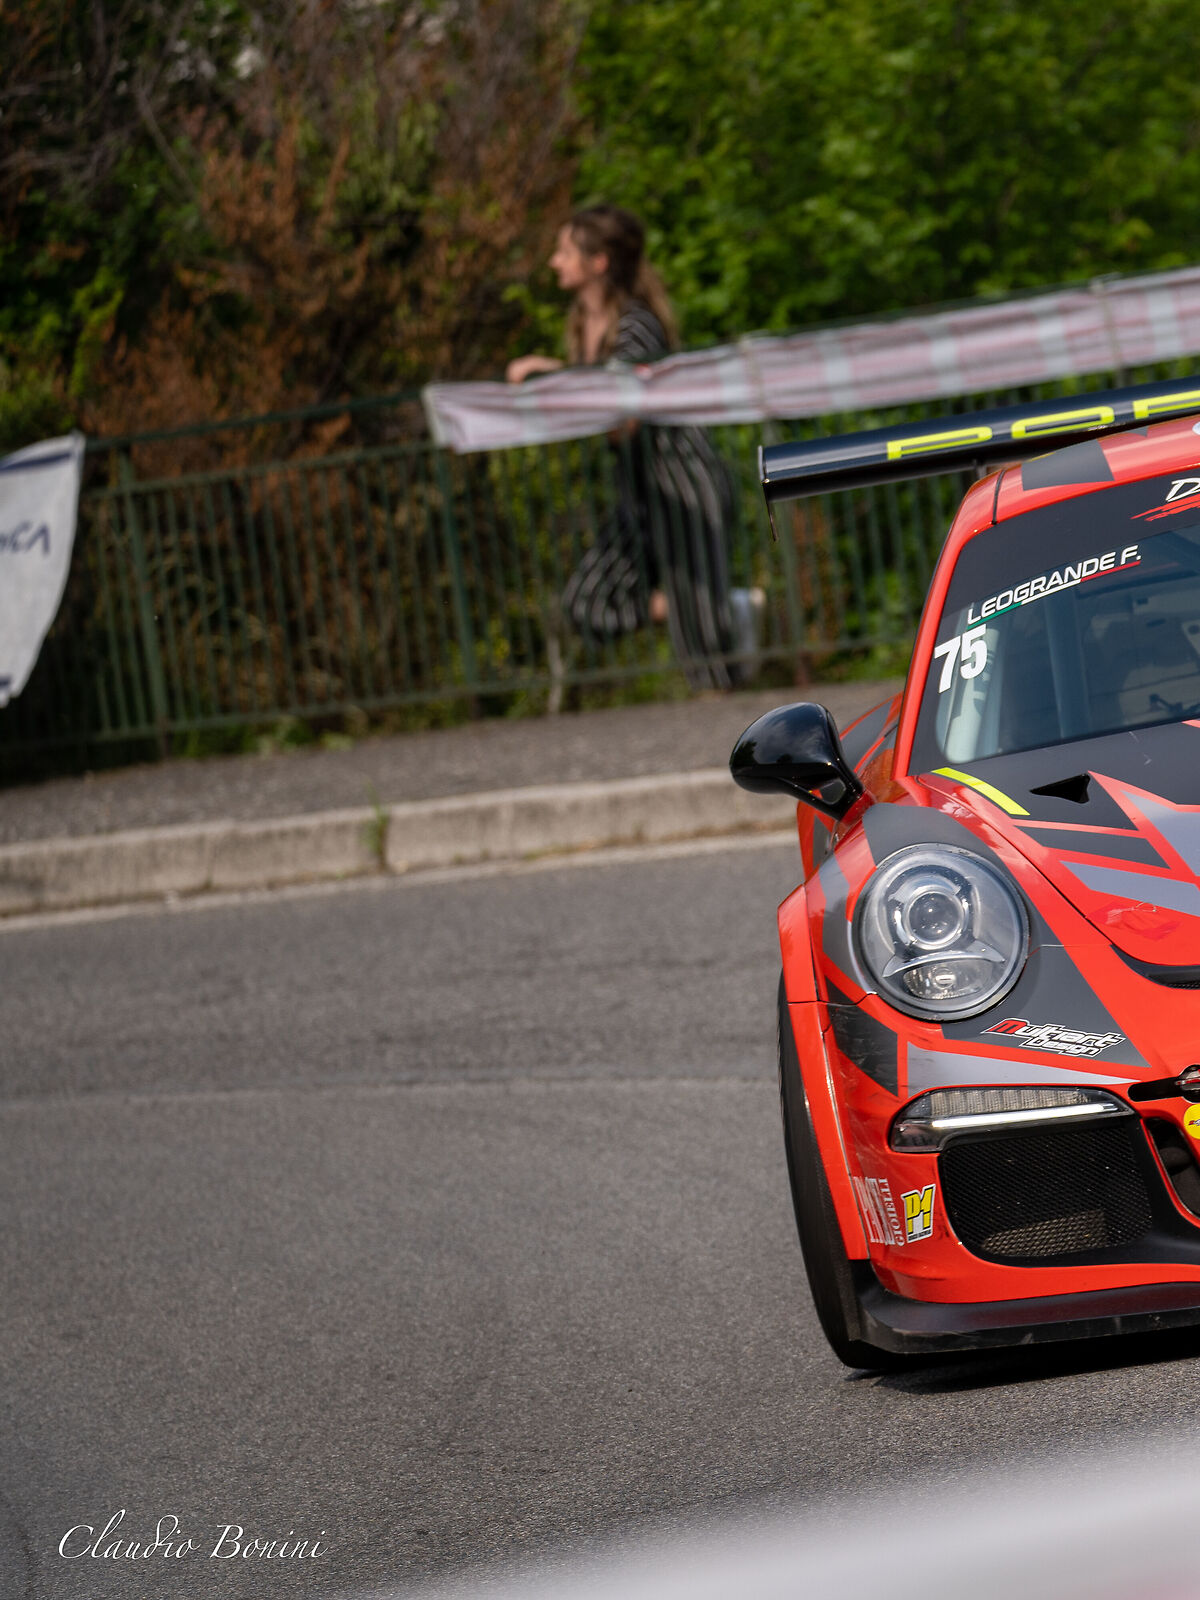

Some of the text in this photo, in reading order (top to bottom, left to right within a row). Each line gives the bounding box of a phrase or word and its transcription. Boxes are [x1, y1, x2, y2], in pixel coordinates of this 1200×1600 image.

[967, 545, 1142, 625] LEOGRANDE F.
[934, 624, 988, 694] 75
